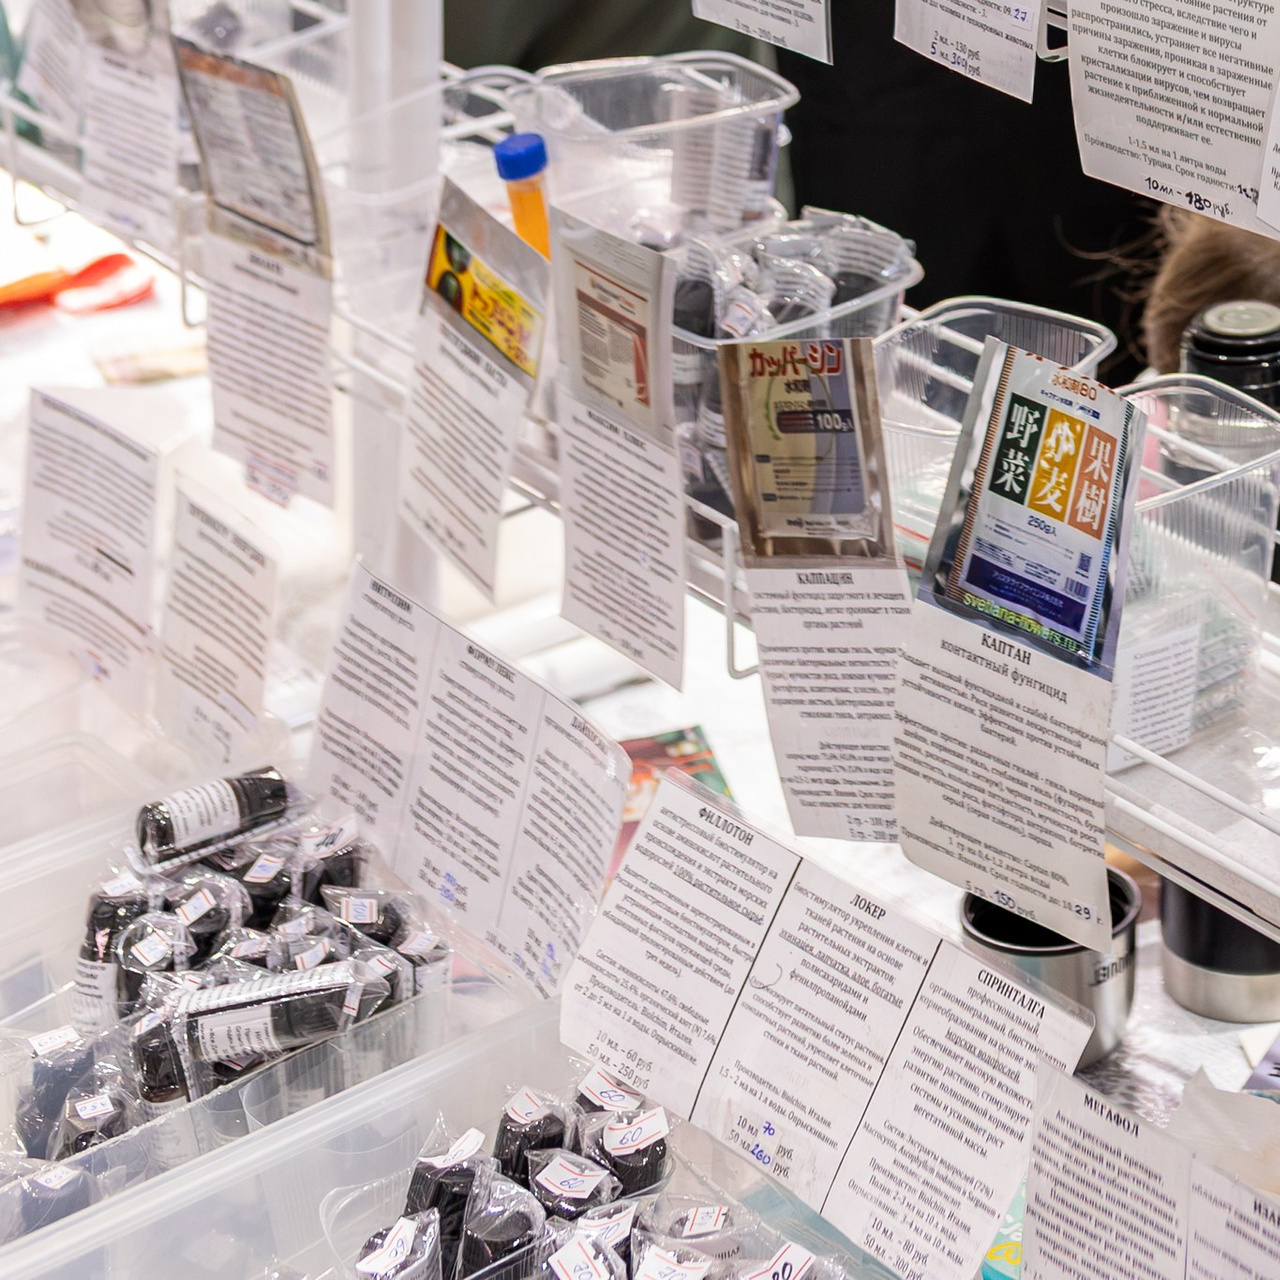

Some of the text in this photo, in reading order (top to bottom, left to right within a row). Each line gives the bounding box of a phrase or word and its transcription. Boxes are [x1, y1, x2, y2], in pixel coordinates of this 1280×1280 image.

[995, 403, 1041, 494] 野菜
[1075, 436, 1112, 531] 果樹
[981, 633, 1031, 665] КАПТАН
[940, 639, 1067, 704] контактный фунгицид
[850, 894, 886, 920] ЛОКЕР
[978, 969, 1045, 1018] СПРИНТАЛГА
[599, 1088, 626, 1103] 60
[1084, 1093, 1138, 1137] МЕГАФОЛ
[619, 1127, 643, 1146] 60
